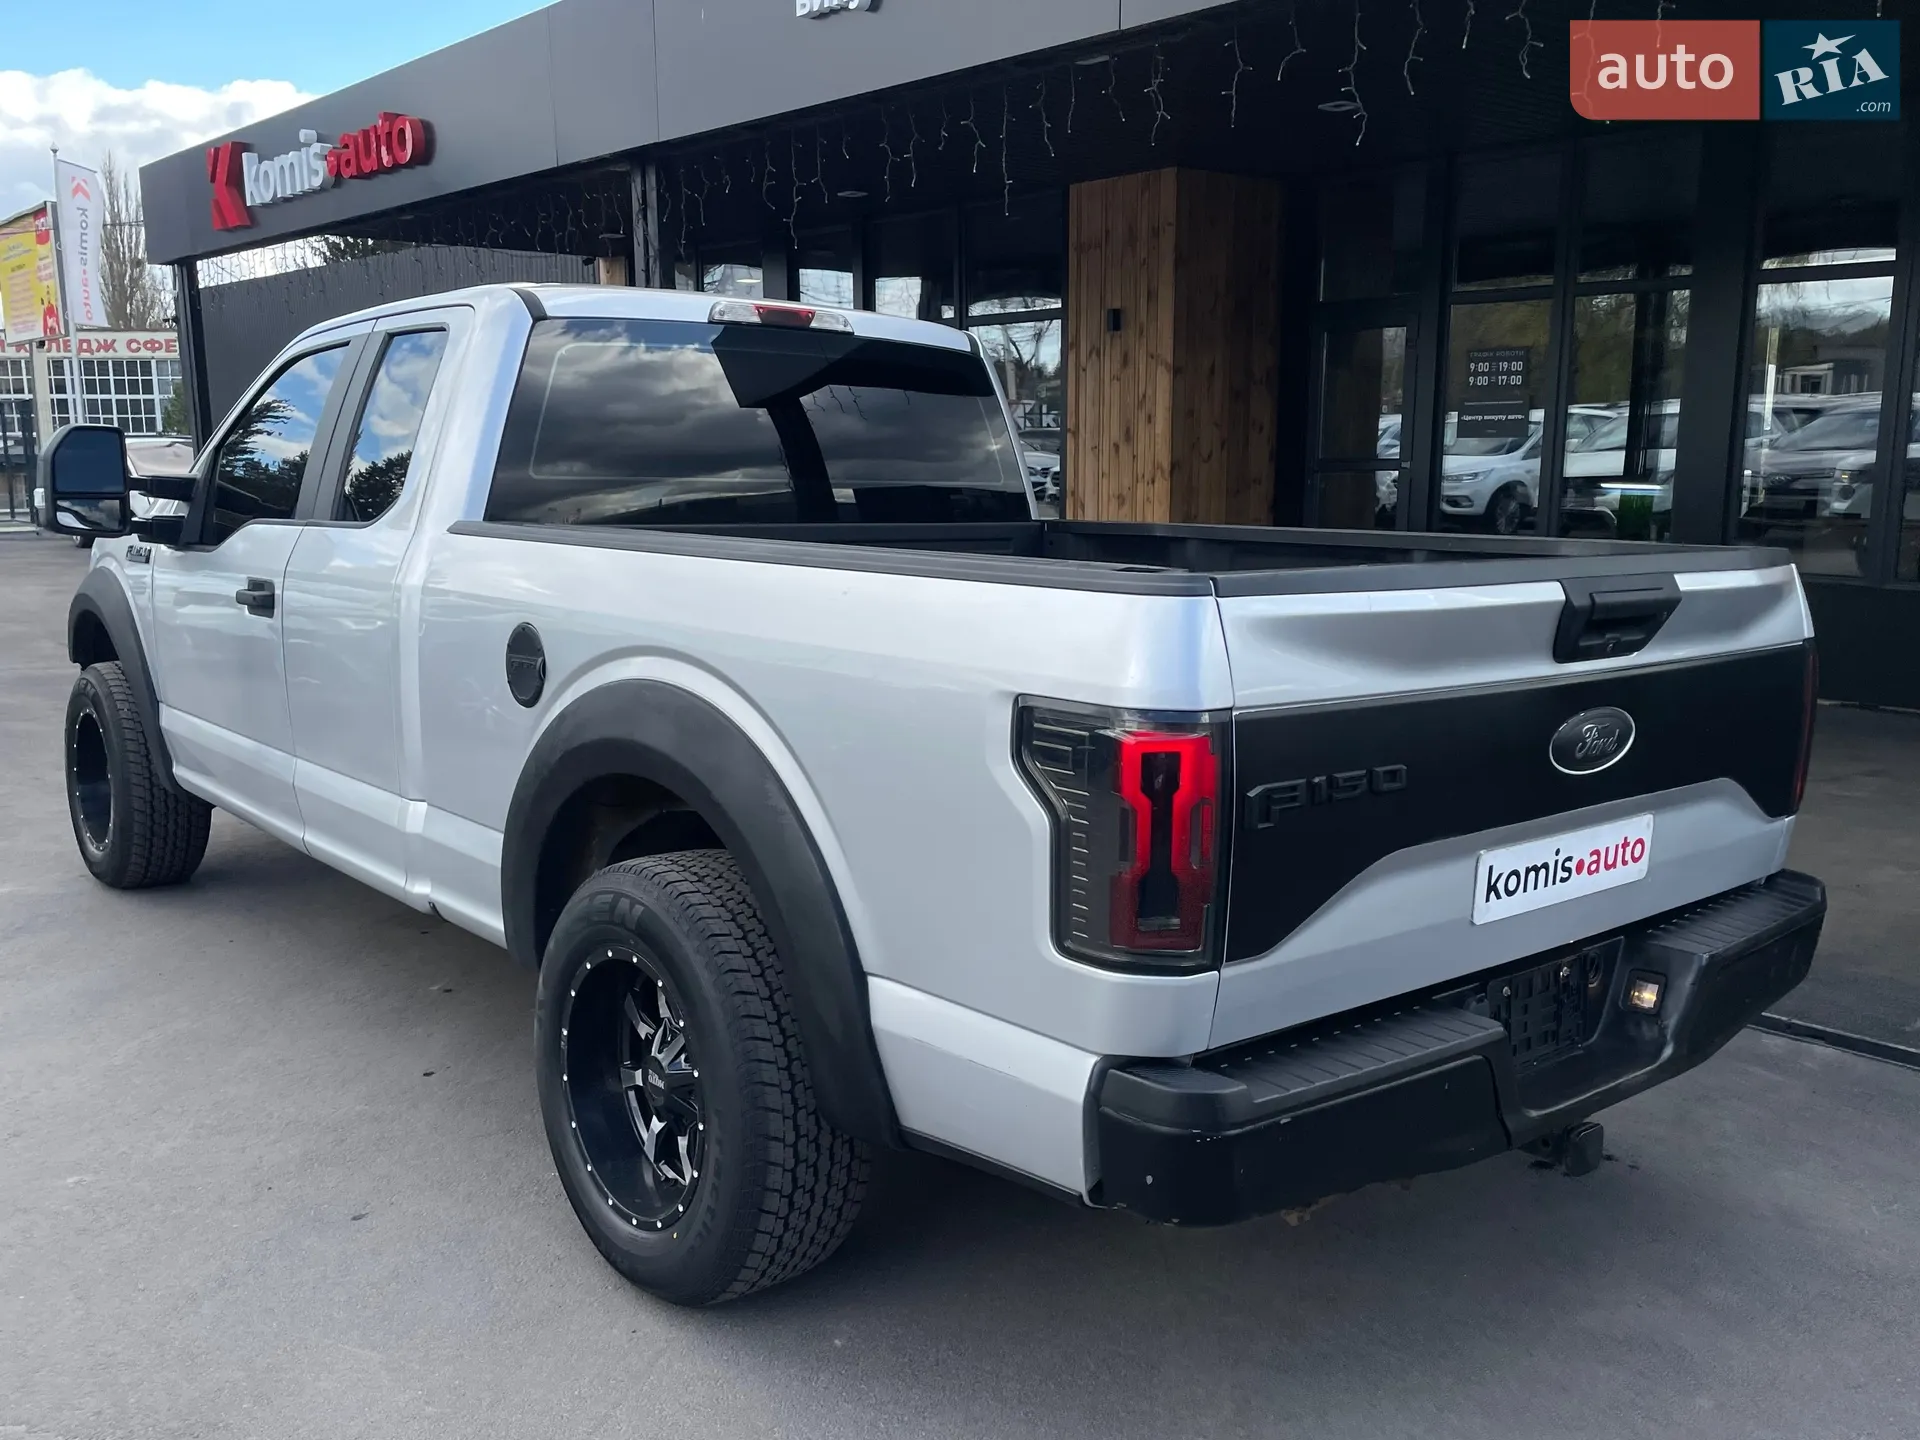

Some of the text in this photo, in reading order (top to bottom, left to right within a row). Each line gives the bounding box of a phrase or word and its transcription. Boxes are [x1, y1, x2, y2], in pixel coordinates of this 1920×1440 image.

[126, 338, 177, 353] СФЕ
[1469, 362, 1490, 373] 9:00
[1499, 361, 1523, 372] 19:00
[1468, 376, 1489, 387] 9:00
[1498, 375, 1522, 386] 17:00
[1575, 723, 1620, 760] Ford
